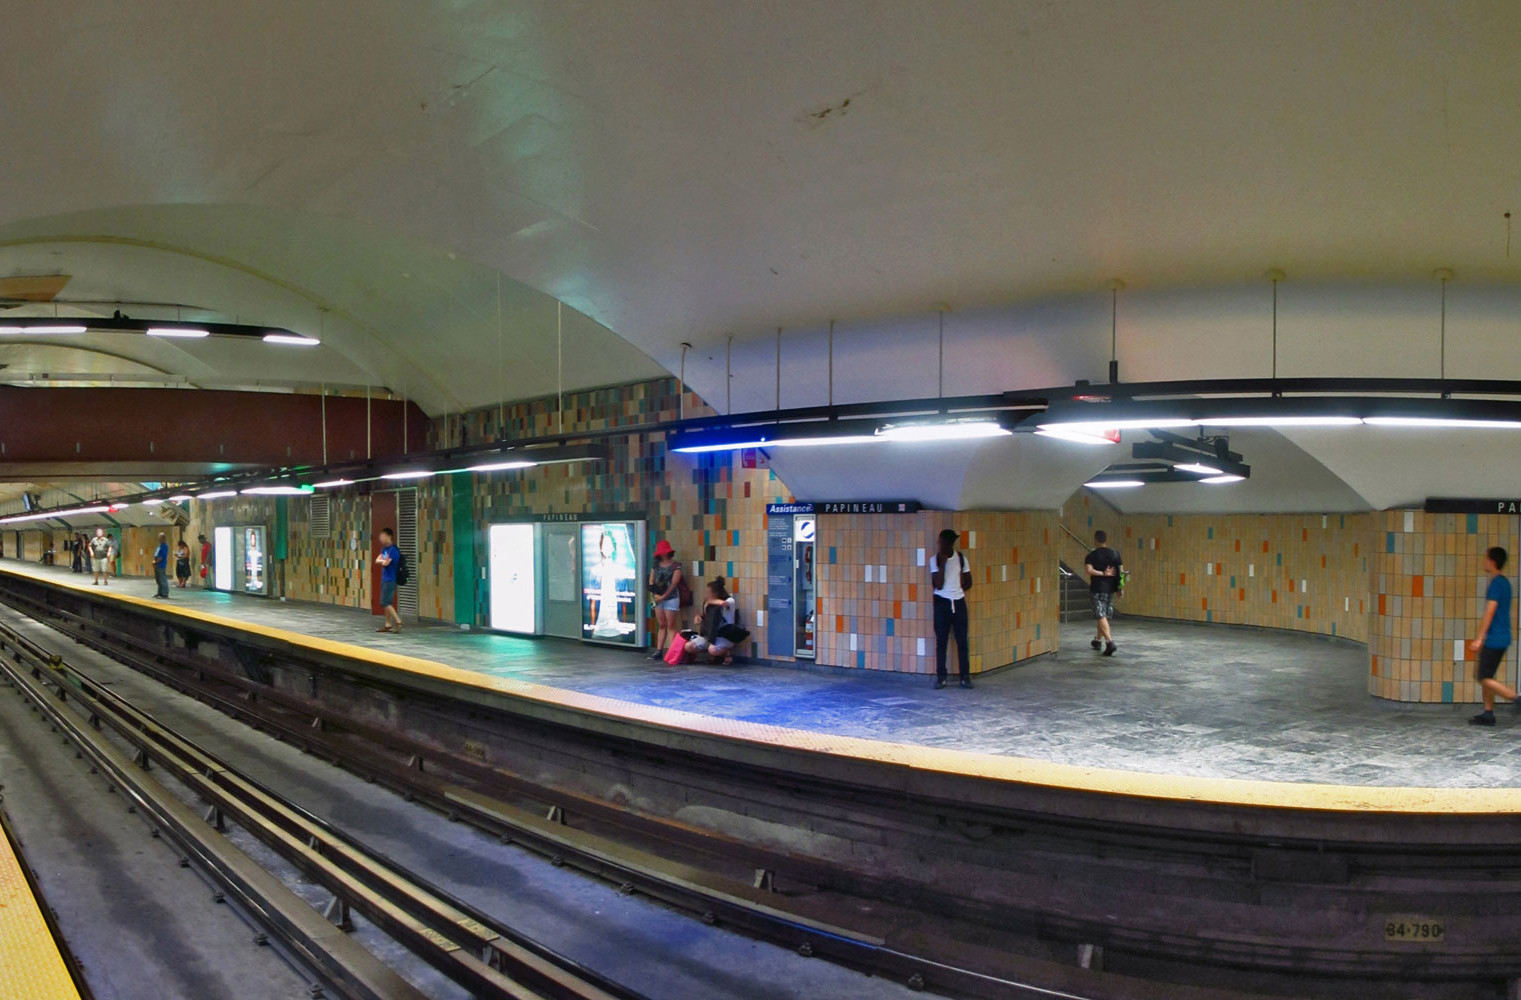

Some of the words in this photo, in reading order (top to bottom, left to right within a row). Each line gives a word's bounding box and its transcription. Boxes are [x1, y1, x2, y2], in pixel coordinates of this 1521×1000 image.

[769, 504, 811, 513] Assistance
[825, 503, 883, 513] PAPINEAU
[543, 513, 578, 521] PAPINEAU
